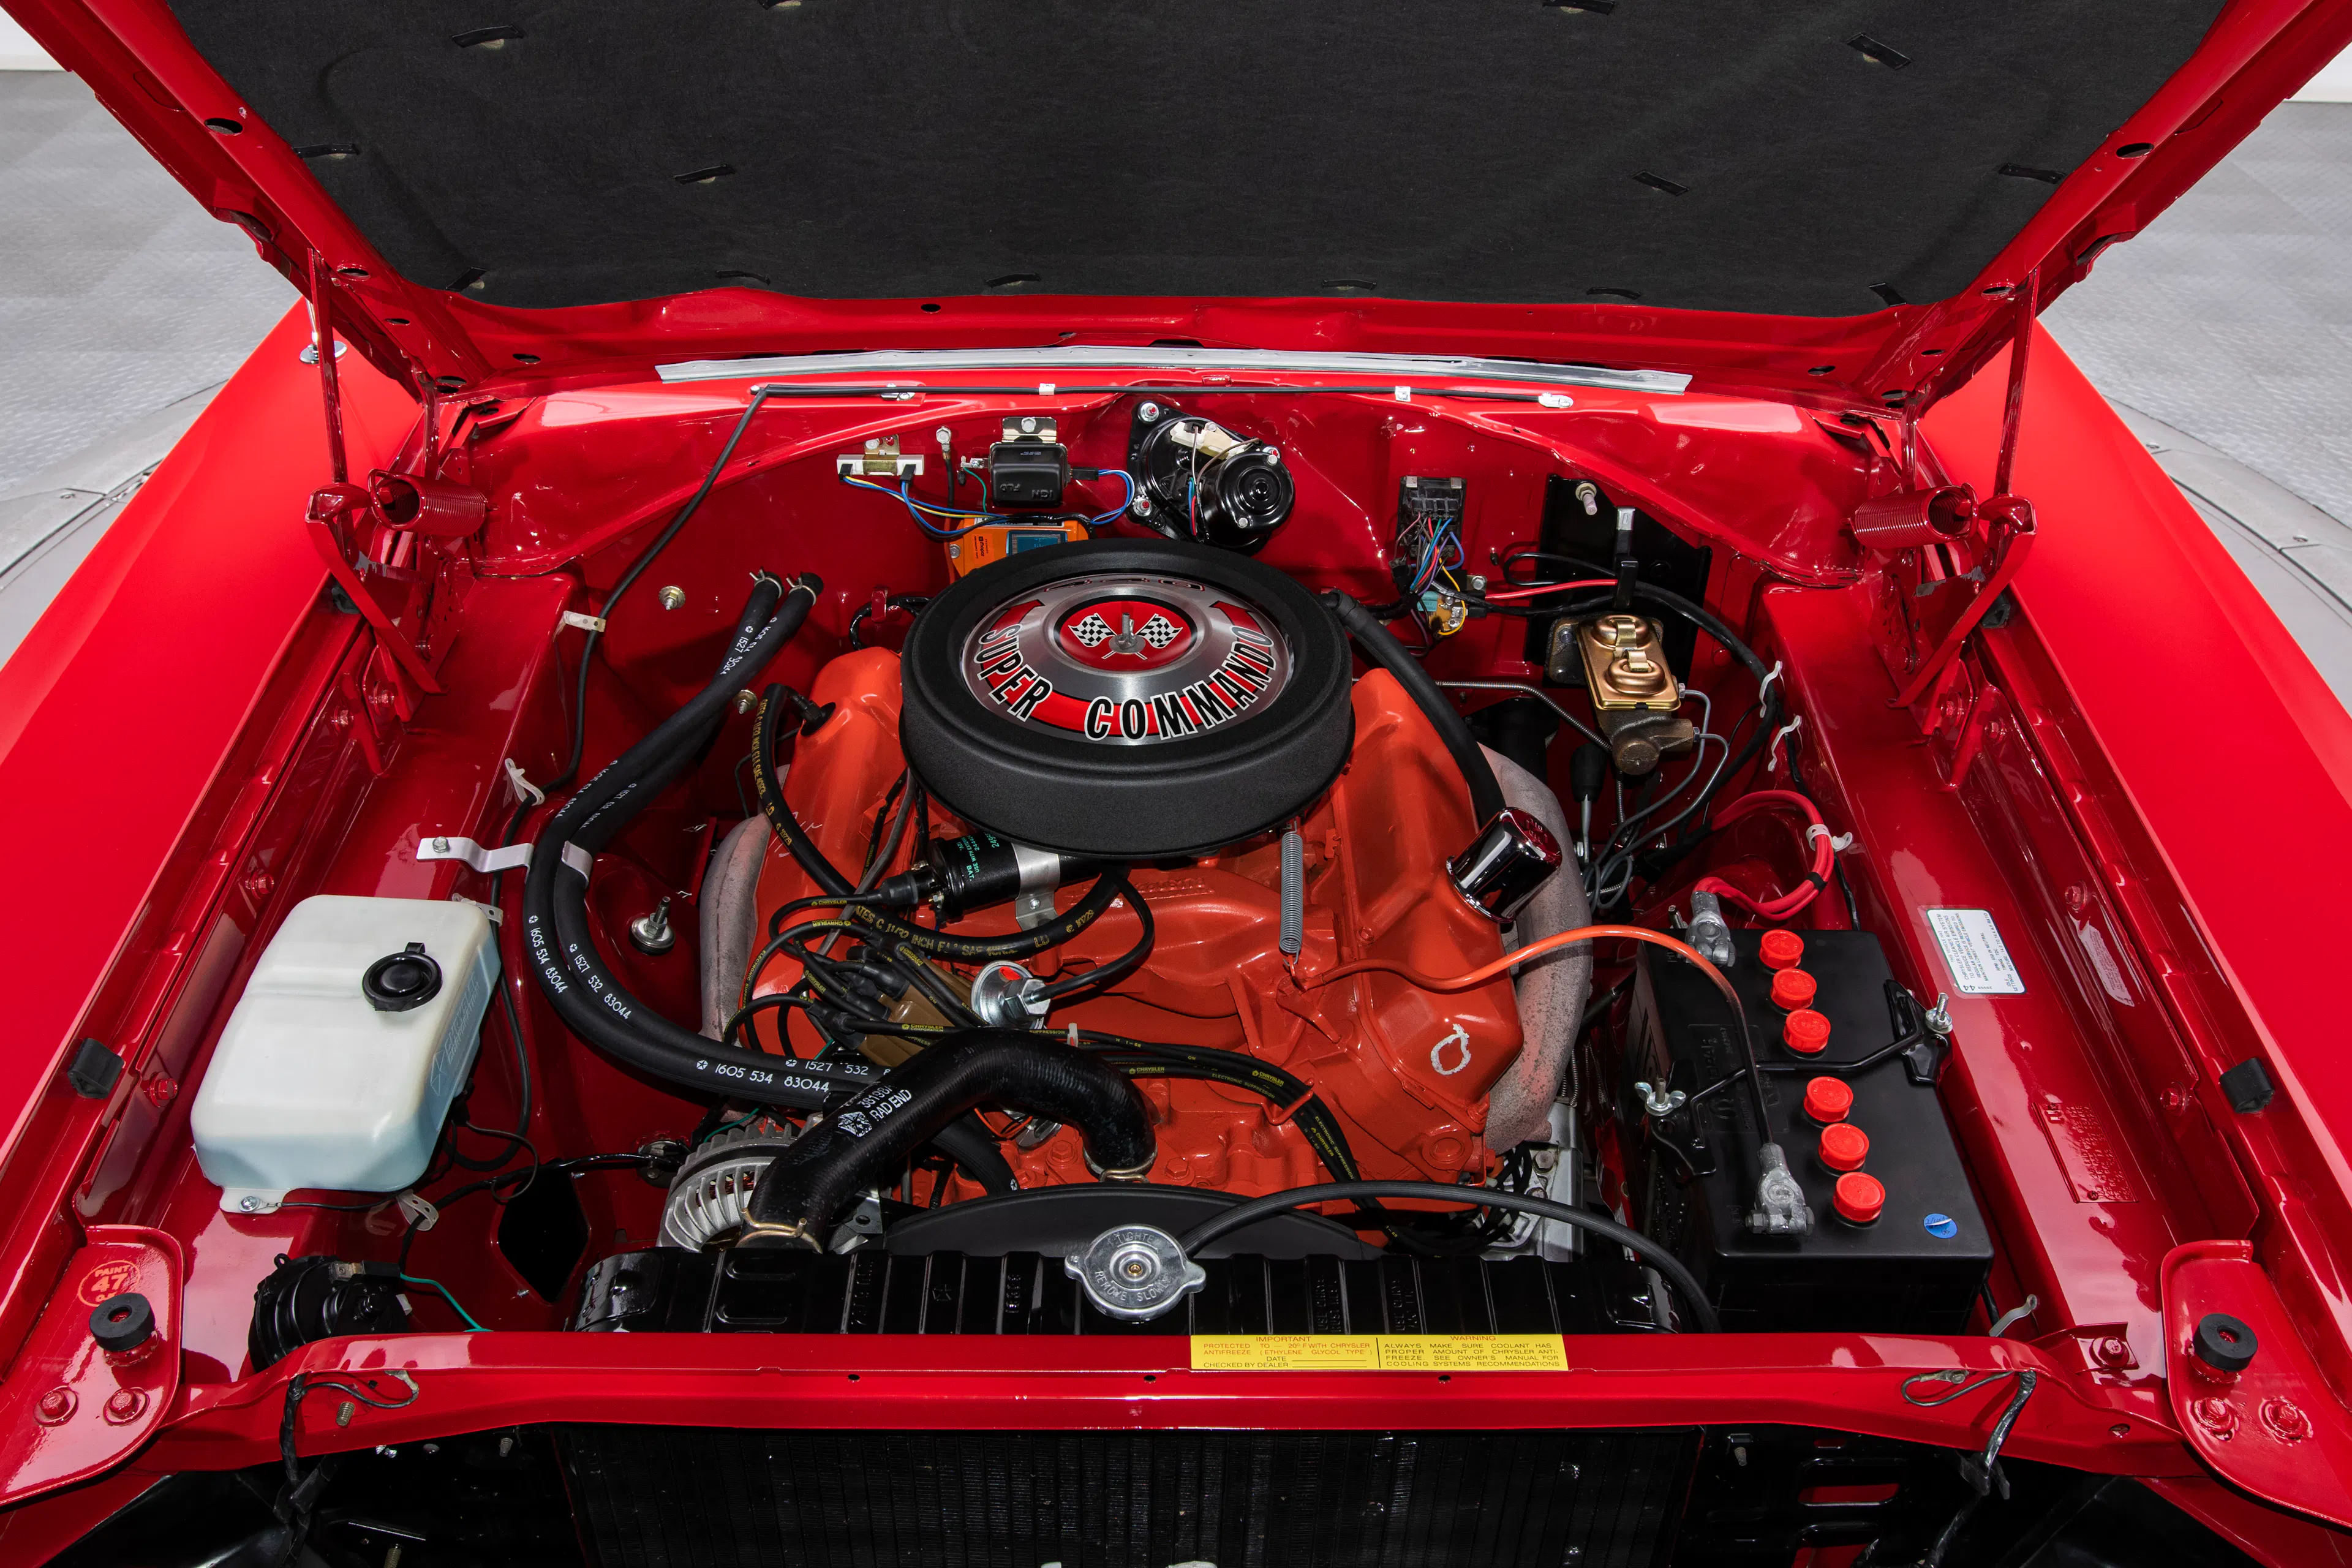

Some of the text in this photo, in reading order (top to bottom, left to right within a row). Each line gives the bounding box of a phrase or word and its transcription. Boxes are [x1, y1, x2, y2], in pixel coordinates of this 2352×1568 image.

[734, 636, 748, 653] 1527
[974, 624, 1276, 741] SUPER COMMANDO
[966, 865, 974, 881] BAT.
[1936, 914, 1947, 929] SYSTEM
[911, 934, 933, 950] INCH
[1947, 938, 1959, 957] CLEANER
[530, 927, 568, 993] 1605 534 83044
[747, 949, 766, 981] ELECTRONIC
[1956, 958, 1969, 979] CHRYSLER
[1961, 956, 1972, 971] REDUCE
[575, 954, 631, 1019] 1527 532 83044
[715, 1063, 829, 1093] 1605 534 83044
[805, 1061, 869, 1075] 1527 532
[1259, 1071, 1284, 1085] CHRYSLER
[1212, 1073, 1275, 1099] ELECTRONIC SUPPRESSION
[870, 1089, 912, 1121] RAD END
[1314, 1116, 1355, 1180] ELECTRONIC SUPPRESSION
[1316, 1133, 1334, 1156] CHRYSLER
[95, 1265, 130, 1278] PAINT
[91, 1273, 128, 1292] 47
[1095, 1270, 1126, 1301] REMOVE
